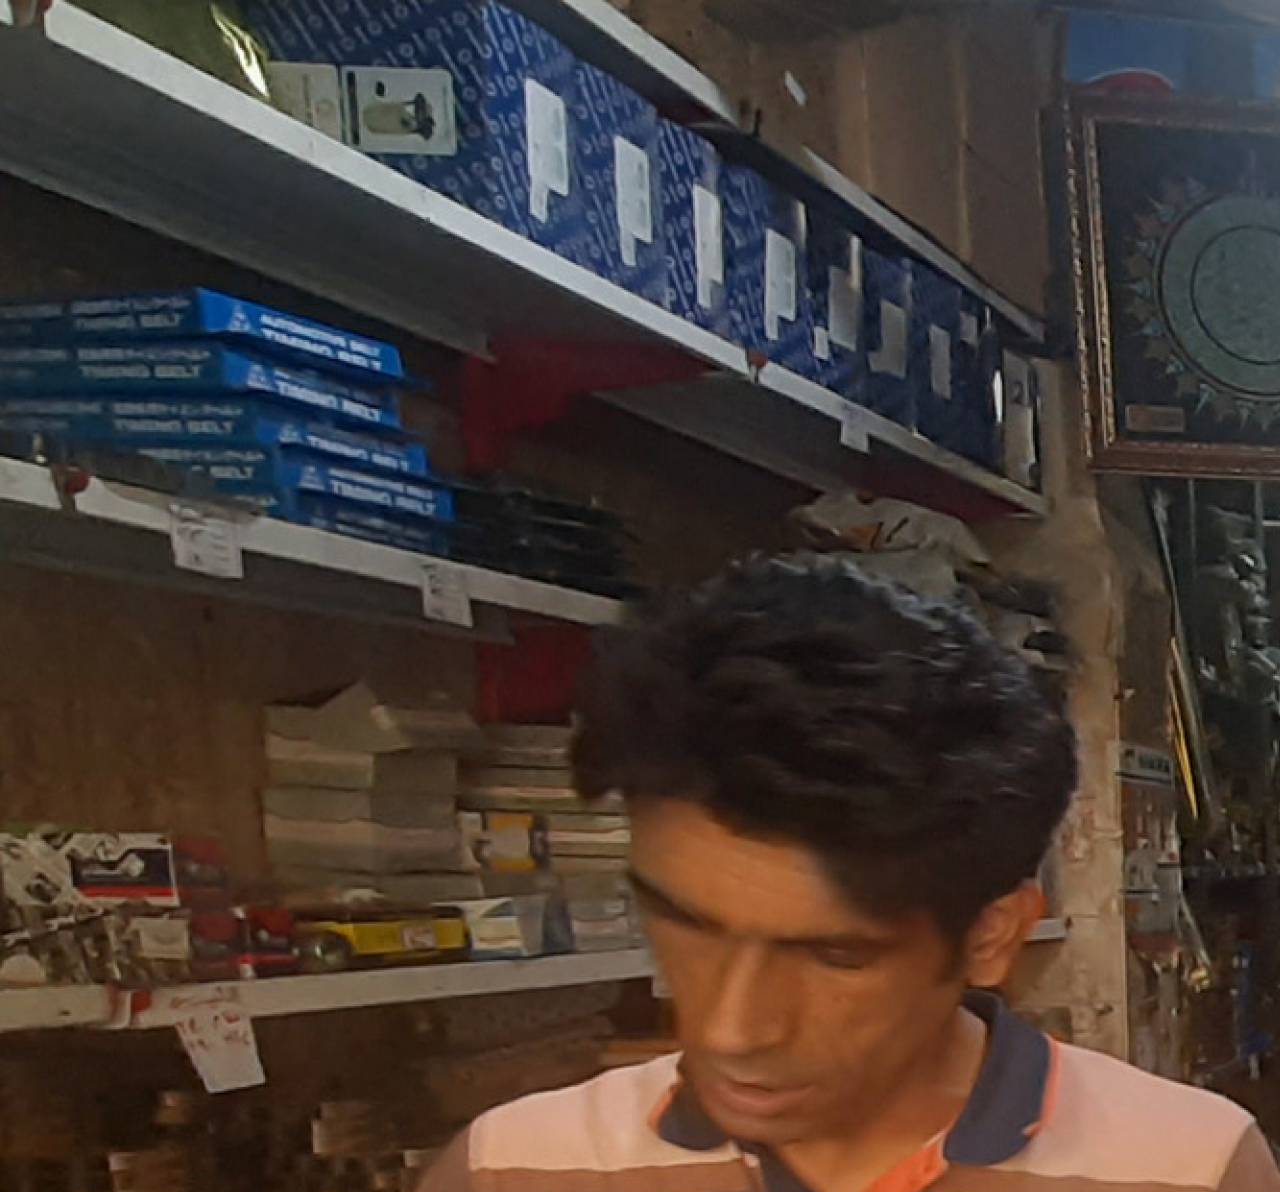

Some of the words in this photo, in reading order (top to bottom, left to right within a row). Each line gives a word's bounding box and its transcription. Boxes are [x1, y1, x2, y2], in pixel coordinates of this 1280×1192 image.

[154, 362, 201, 379] BELT
[275, 380, 338, 410] TIMING
[341, 398, 382, 423] BELT
[187, 417, 235, 434] BELT
[330, 480, 391, 509] TIMING
